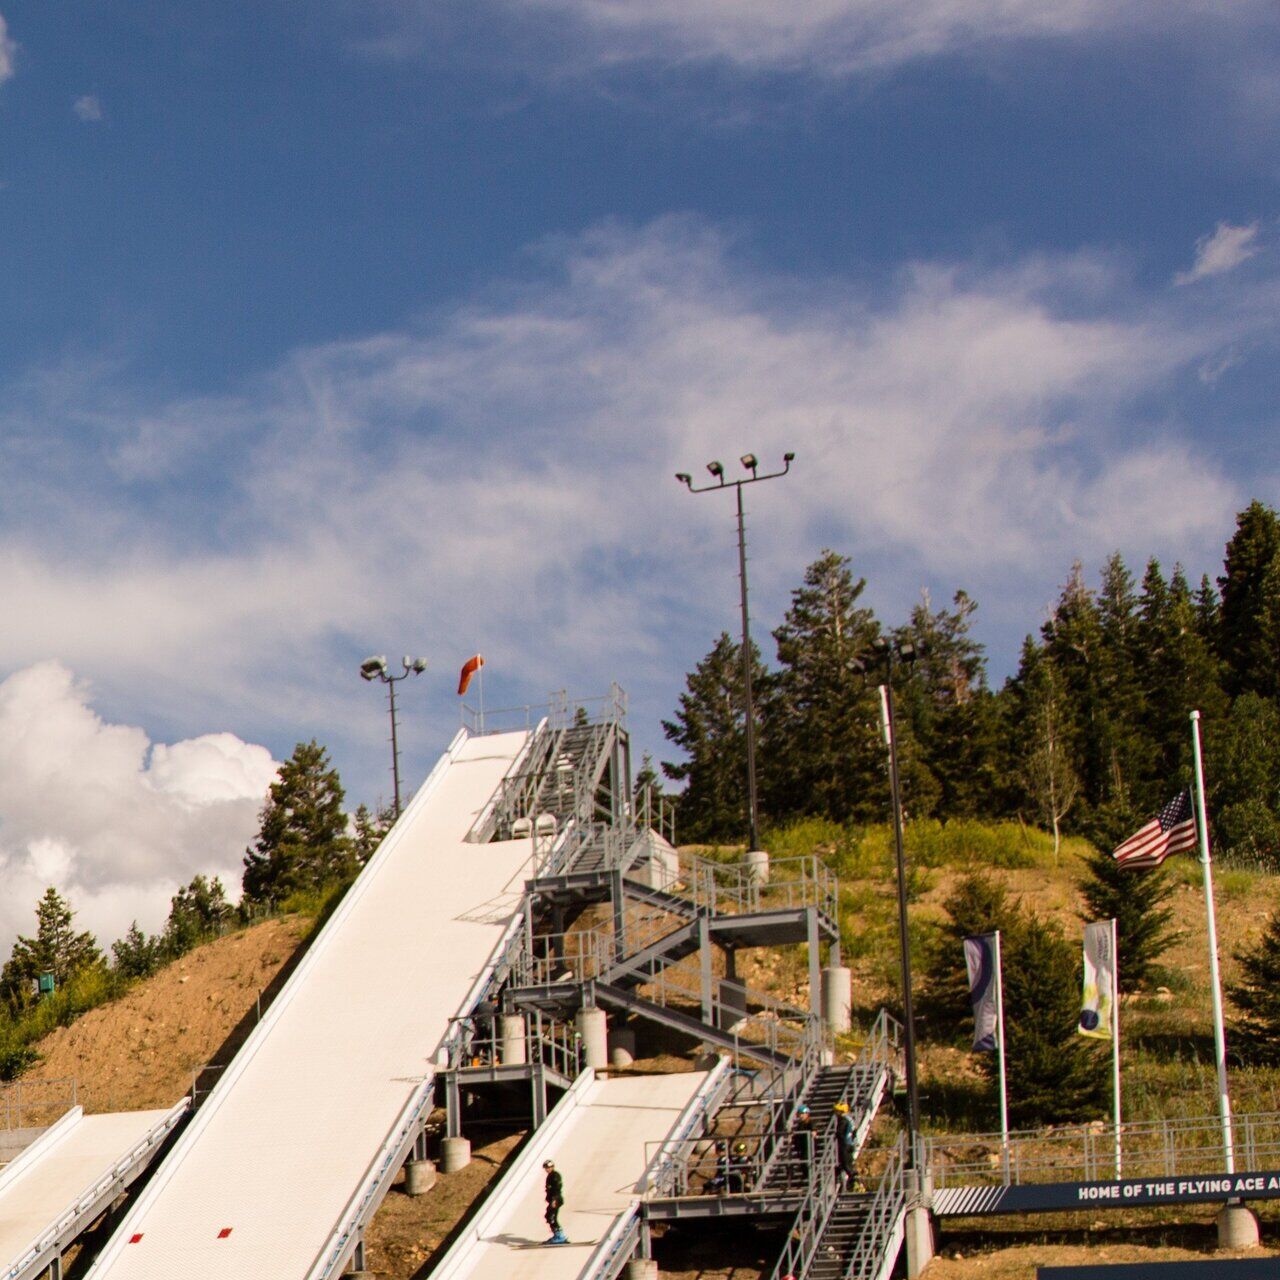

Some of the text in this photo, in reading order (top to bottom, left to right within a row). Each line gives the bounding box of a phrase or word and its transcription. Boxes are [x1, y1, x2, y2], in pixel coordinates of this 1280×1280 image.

[1078, 1176, 1280, 1200] HOME OF THE FLYING ACE A
